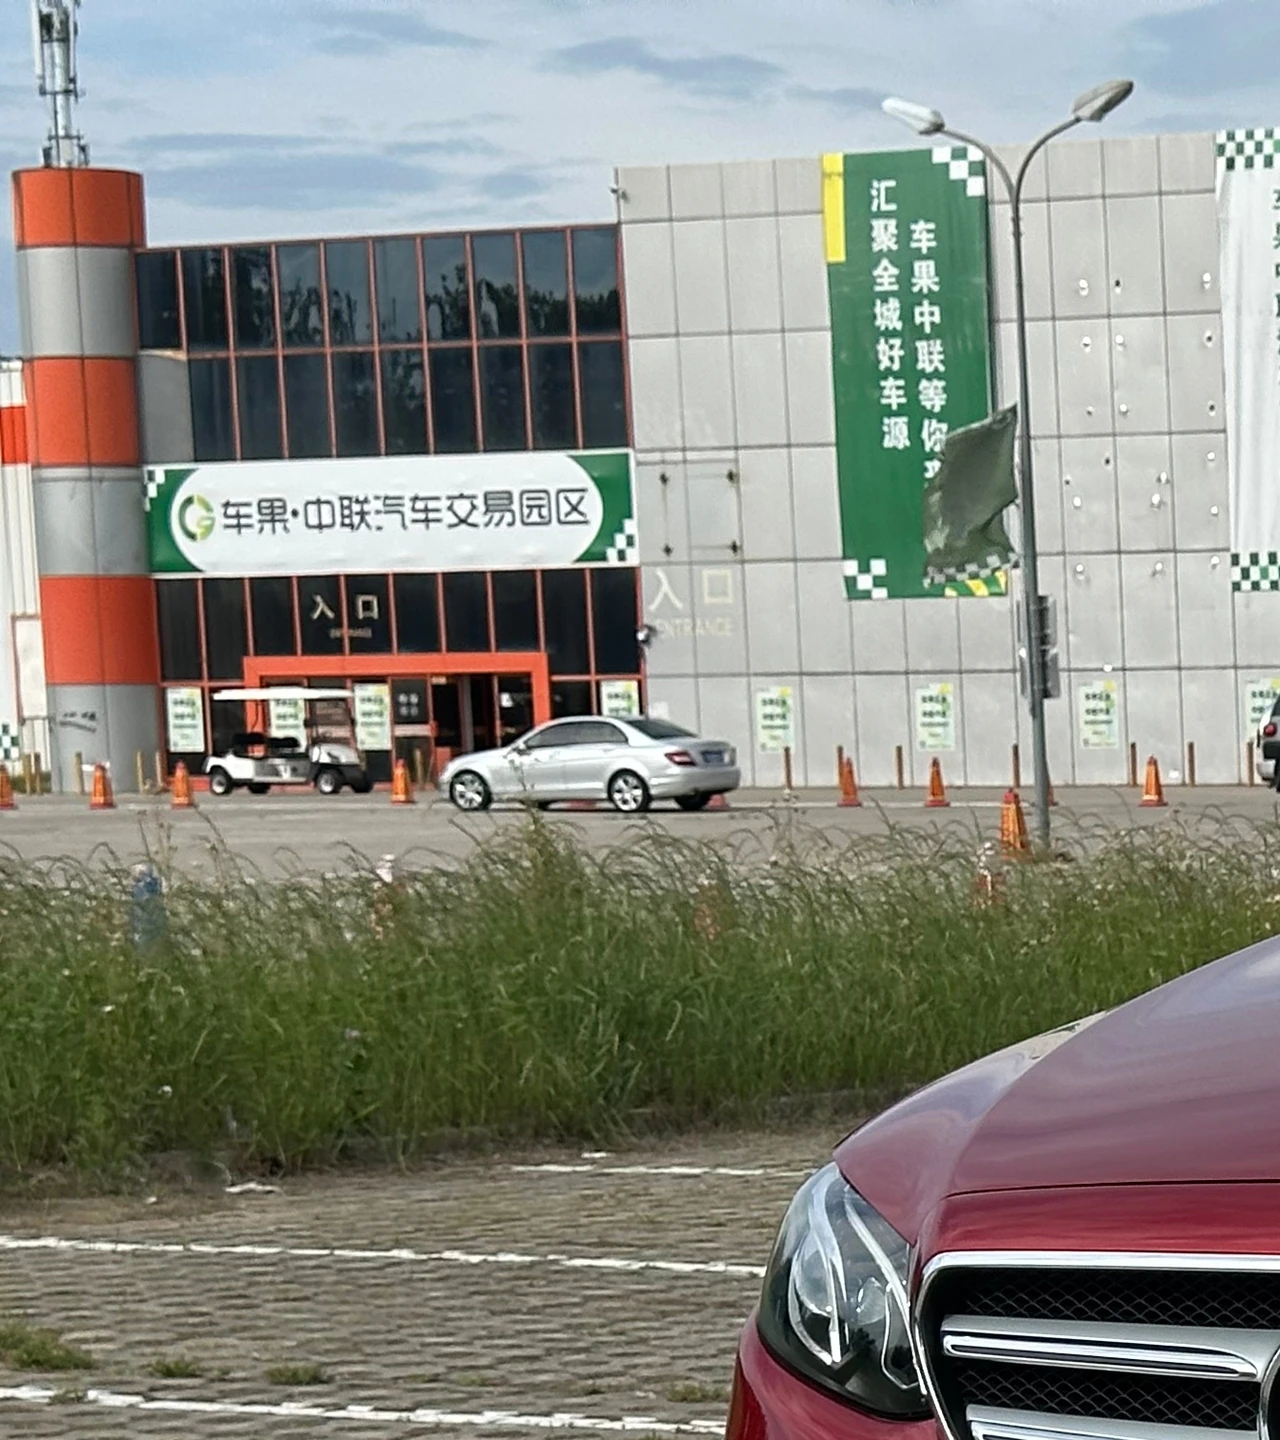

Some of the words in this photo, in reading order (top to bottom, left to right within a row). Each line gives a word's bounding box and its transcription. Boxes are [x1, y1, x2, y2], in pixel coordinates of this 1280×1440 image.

[870, 179, 911, 450] 汇聚全城好车源
[220, 488, 589, 534] 车果·中联汽车交易园区
[310, 594, 379, 620] 入口
[649, 568, 734, 612] 入口
